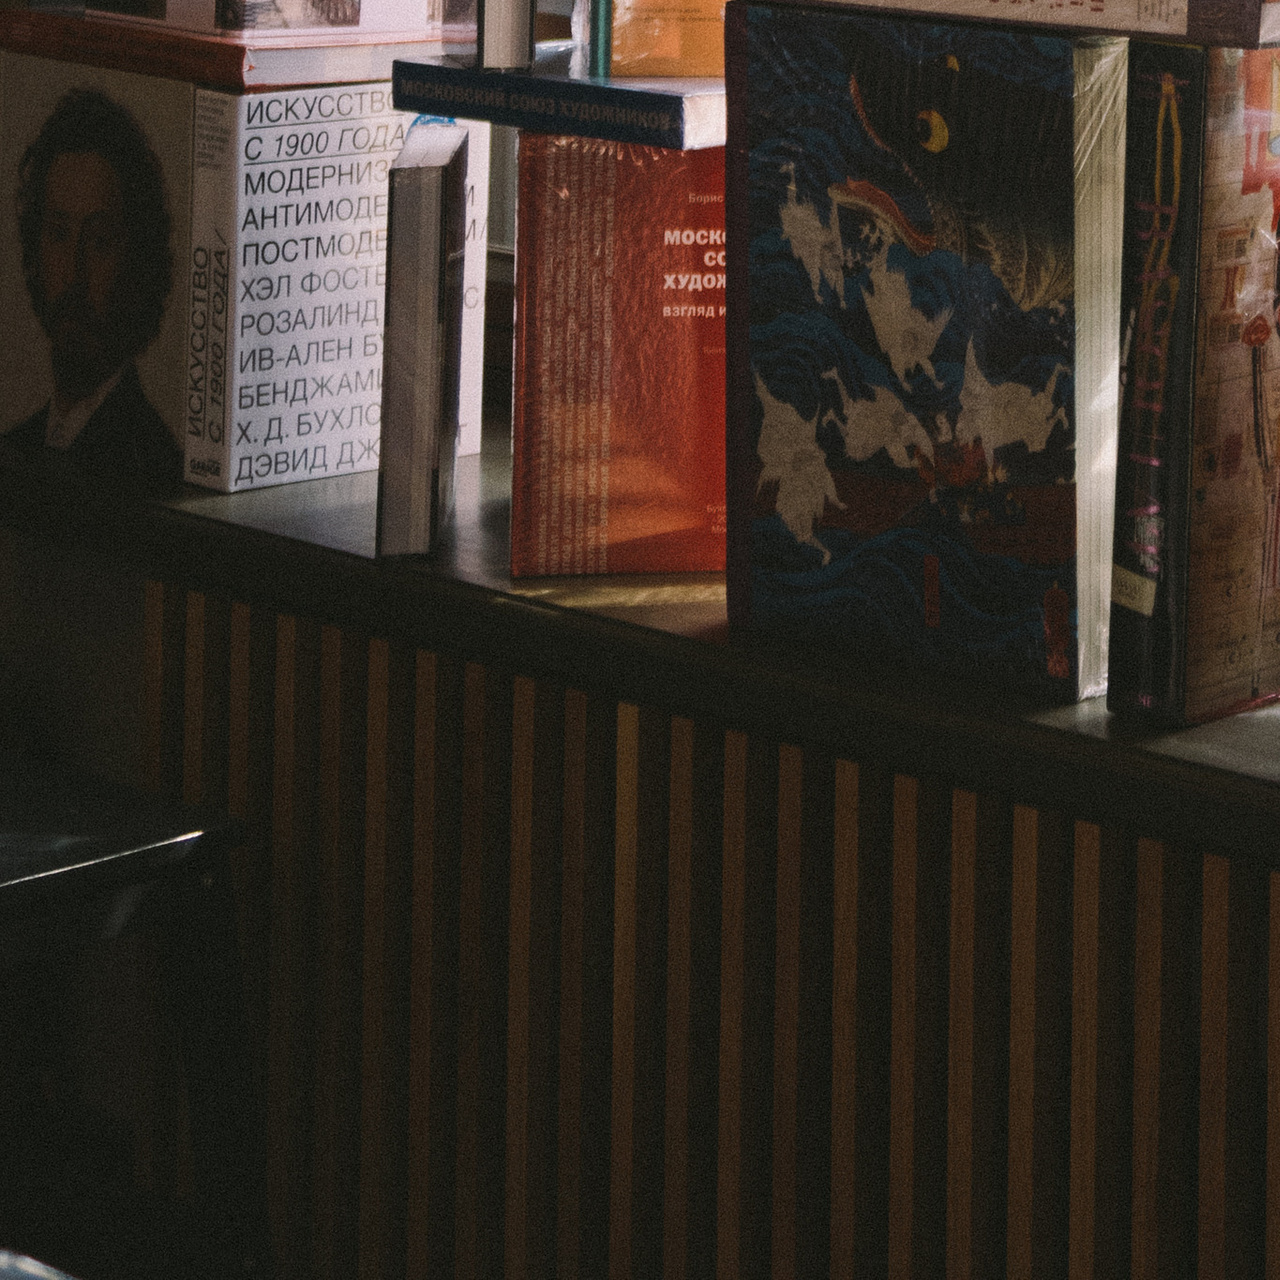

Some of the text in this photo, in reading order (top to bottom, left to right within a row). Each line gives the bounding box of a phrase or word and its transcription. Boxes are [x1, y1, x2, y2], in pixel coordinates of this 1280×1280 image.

[400, 79, 671, 131] МОСКОВСКИЙ СОЮЗ ХУДОЖНИКОВ
[244, 124, 404, 160] С 1900 ГОДА
[244, 160, 392, 197] МОДЕРНИЗ
[241, 196, 387, 232] АНТИМОДЕ
[688, 193, 724, 204] Борис
[242, 229, 386, 268] ПОСТМОДЕ
[664, 229, 726, 245] МОСК
[241, 275, 291, 303] ХЭЛ
[241, 299, 379, 338] РОЗАЛИНД
[188, 246, 208, 439] ИСКУССТВО
[240, 337, 353, 374] ИВ-АЛЕН
[209, 342, 223, 406] 1900
[234, 444, 327, 486] ДЭВИД
